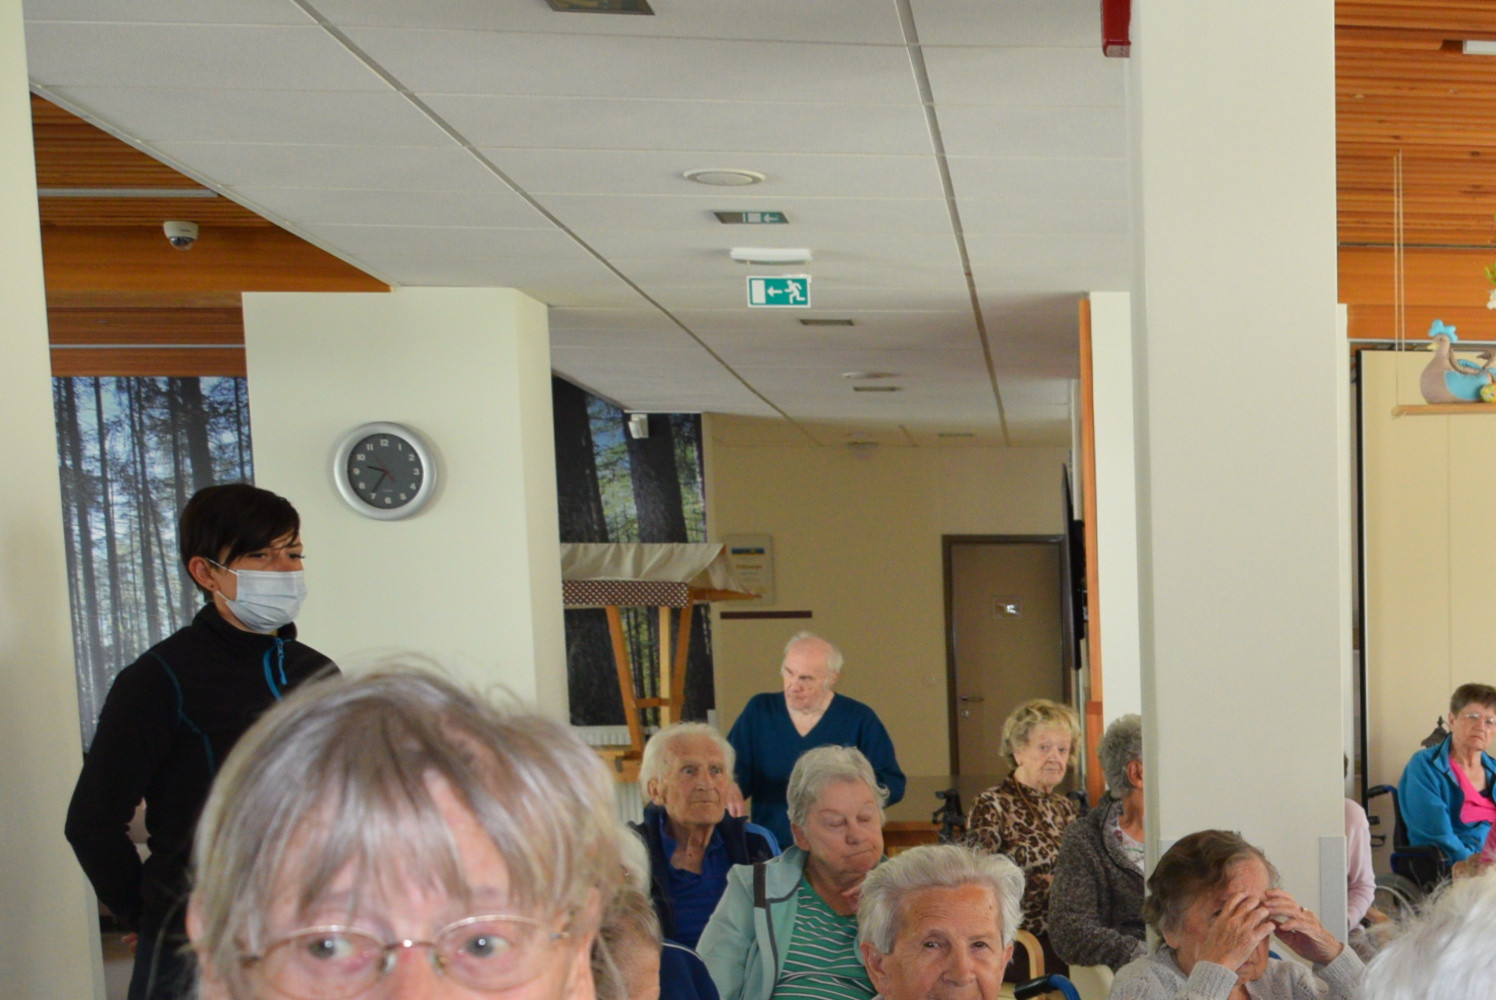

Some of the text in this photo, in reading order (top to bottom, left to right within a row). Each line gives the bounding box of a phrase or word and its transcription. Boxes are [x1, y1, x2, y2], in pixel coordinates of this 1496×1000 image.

[356, 453, 366, 461] 10
[408, 453, 415, 462] 2
[413, 467, 420, 476] 3
[369, 492, 377, 500] 7
